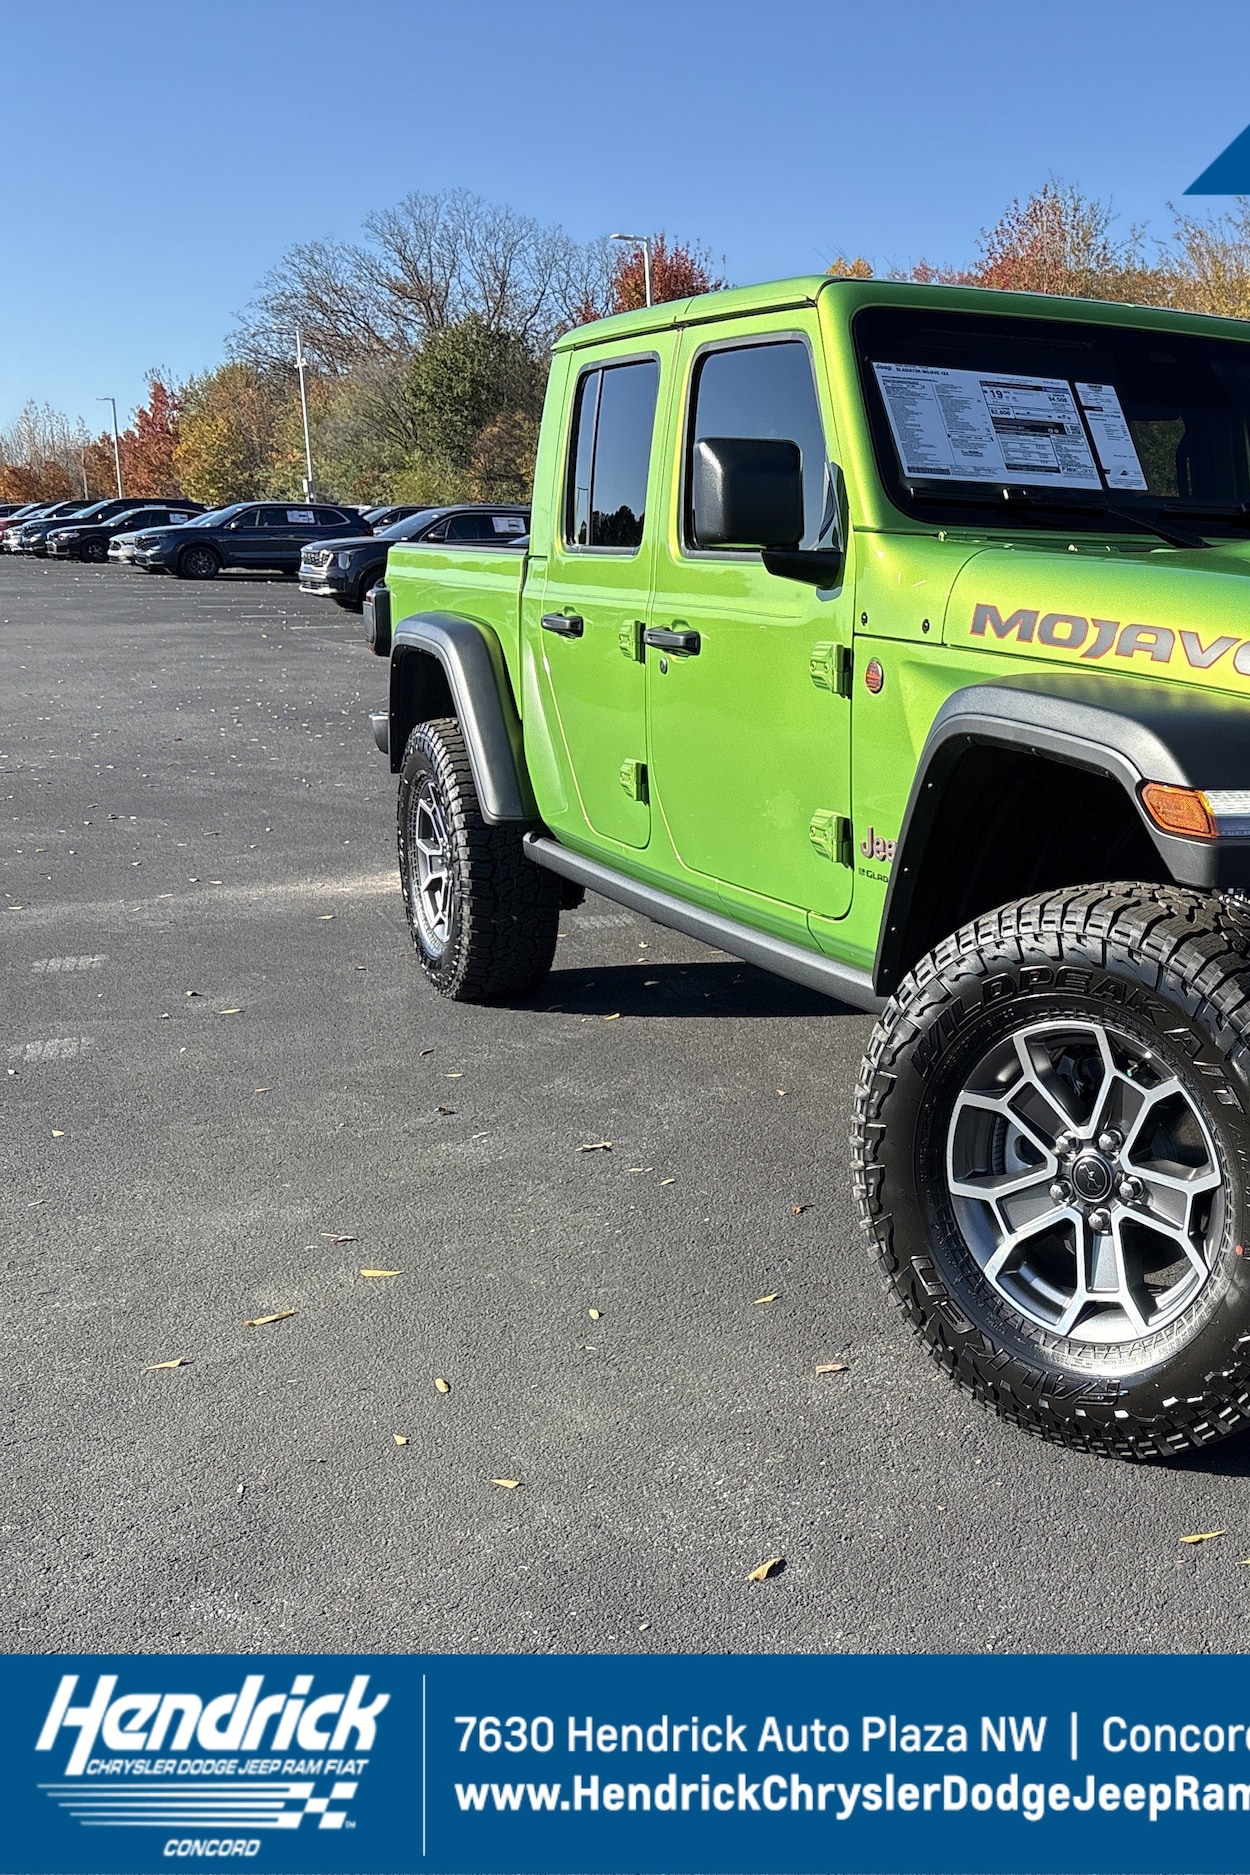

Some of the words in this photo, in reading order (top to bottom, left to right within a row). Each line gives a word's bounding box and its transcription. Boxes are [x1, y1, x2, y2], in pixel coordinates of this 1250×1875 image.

[990, 389, 1003, 399] 19
[860, 826, 897, 863] Jee
[866, 870, 889, 882] GLAD
